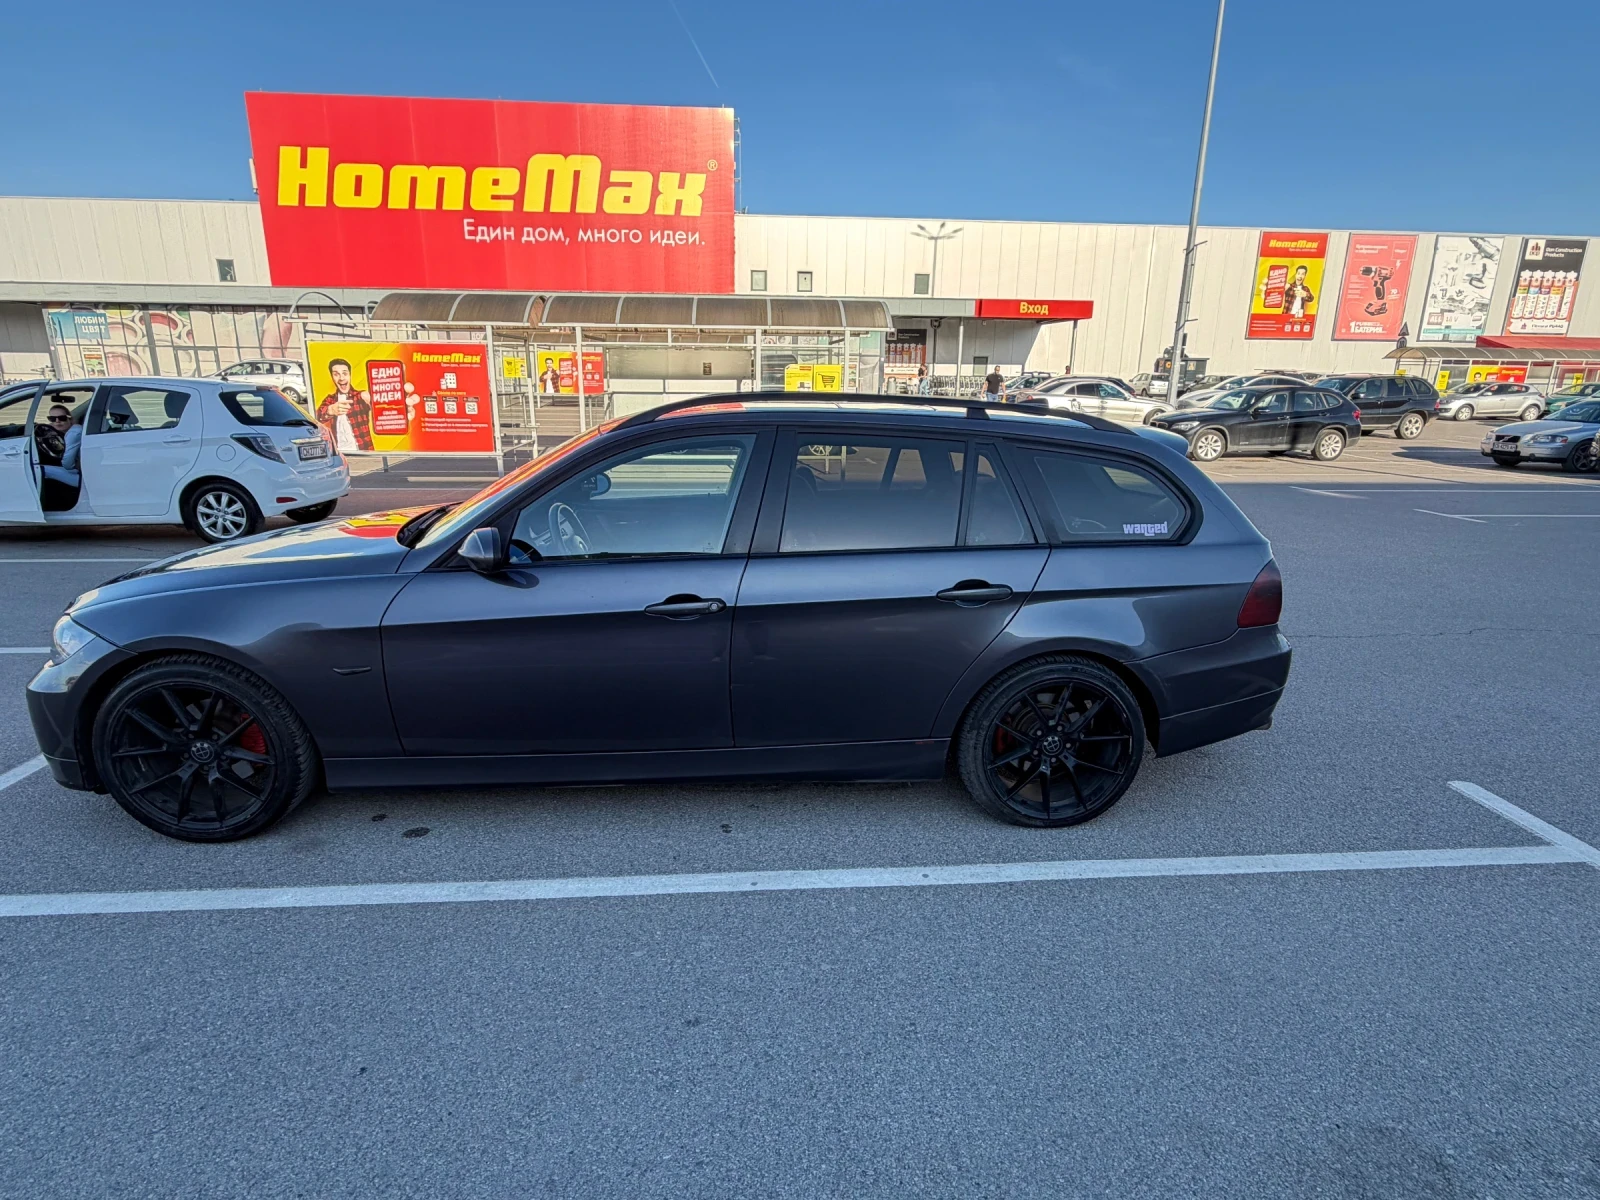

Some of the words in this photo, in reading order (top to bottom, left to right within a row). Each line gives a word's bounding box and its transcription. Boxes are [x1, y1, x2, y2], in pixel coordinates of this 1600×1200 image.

[278, 145, 706, 217] HomeMax
[464, 218, 515, 243] Един
[522, 227, 570, 245] дом,
[577, 229, 643, 243] много
[650, 230, 706, 246] идеи.
[1269, 239, 1319, 249] HomeMax
[1020, 301, 1049, 315] Вход
[74, 316, 106, 324] ЛЮБИМ
[82, 325, 106, 333] ЦВЯТ
[412, 352, 481, 363] HomeMax
[371, 367, 401, 378] ЕДНО
[373, 383, 401, 392] МНОГО
[373, 391, 402, 402] ИДЕИ
[1122, 521, 1168, 536] wanted
